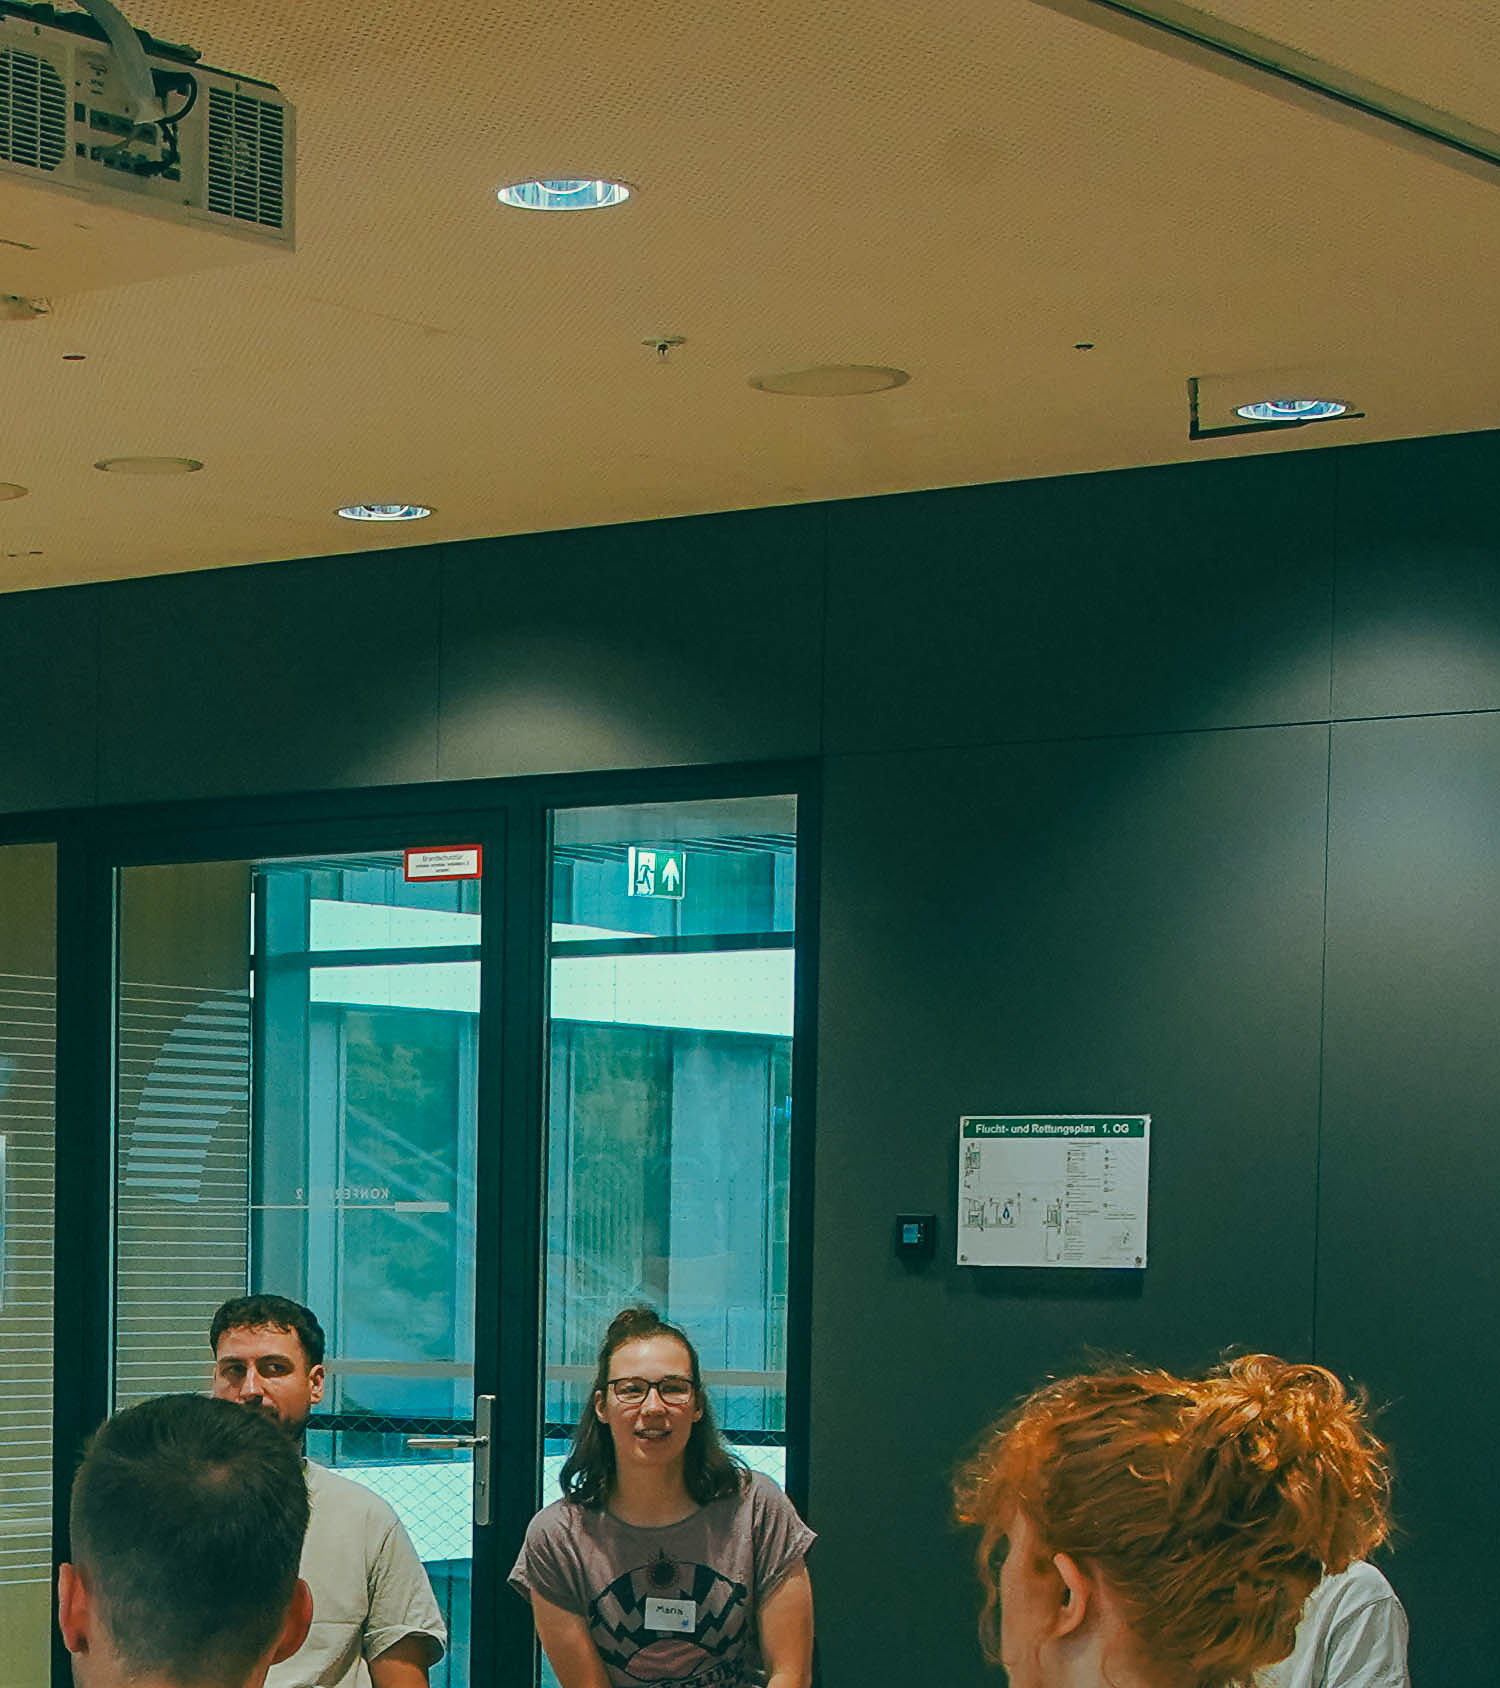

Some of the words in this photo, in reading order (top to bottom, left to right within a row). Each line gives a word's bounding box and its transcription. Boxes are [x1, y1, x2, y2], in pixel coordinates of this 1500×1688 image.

[975, 1123, 1009, 1133] Flucht-
[1010, 1124, 1030, 1133] und
[1032, 1123, 1096, 1135] Rettungsplan
[1102, 1124, 1110, 1133] 1.
[1113, 1124, 1129, 1133] OG
